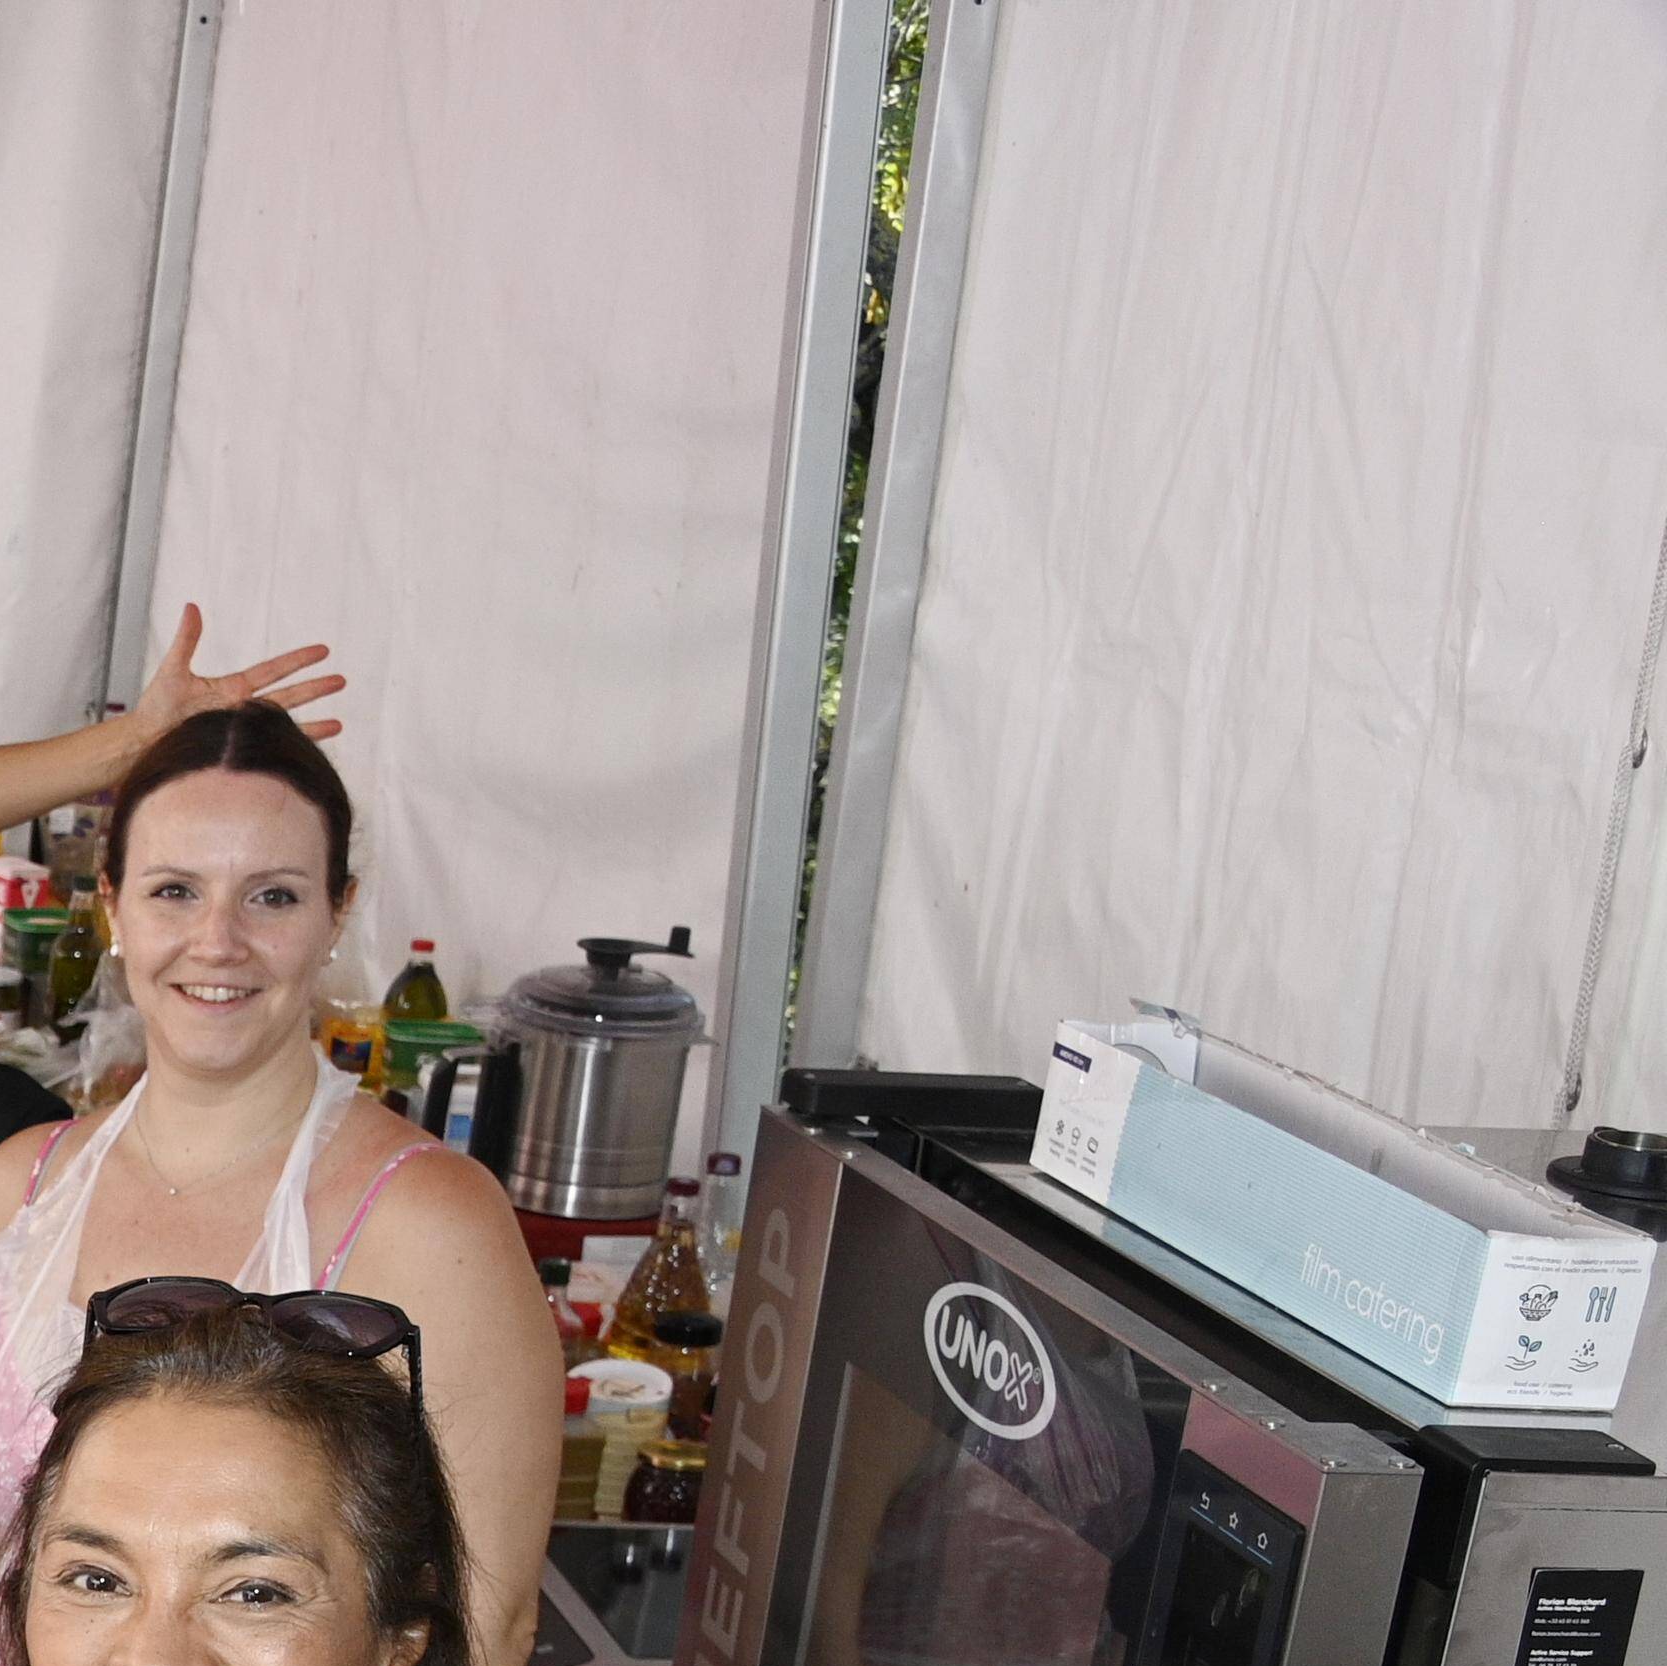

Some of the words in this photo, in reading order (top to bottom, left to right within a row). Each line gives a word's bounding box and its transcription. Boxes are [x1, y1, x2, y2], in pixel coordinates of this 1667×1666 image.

[939, 1304, 1033, 1412] UNOX
[1301, 1243, 1341, 1301] film
[1345, 1281, 1445, 1366] catering
